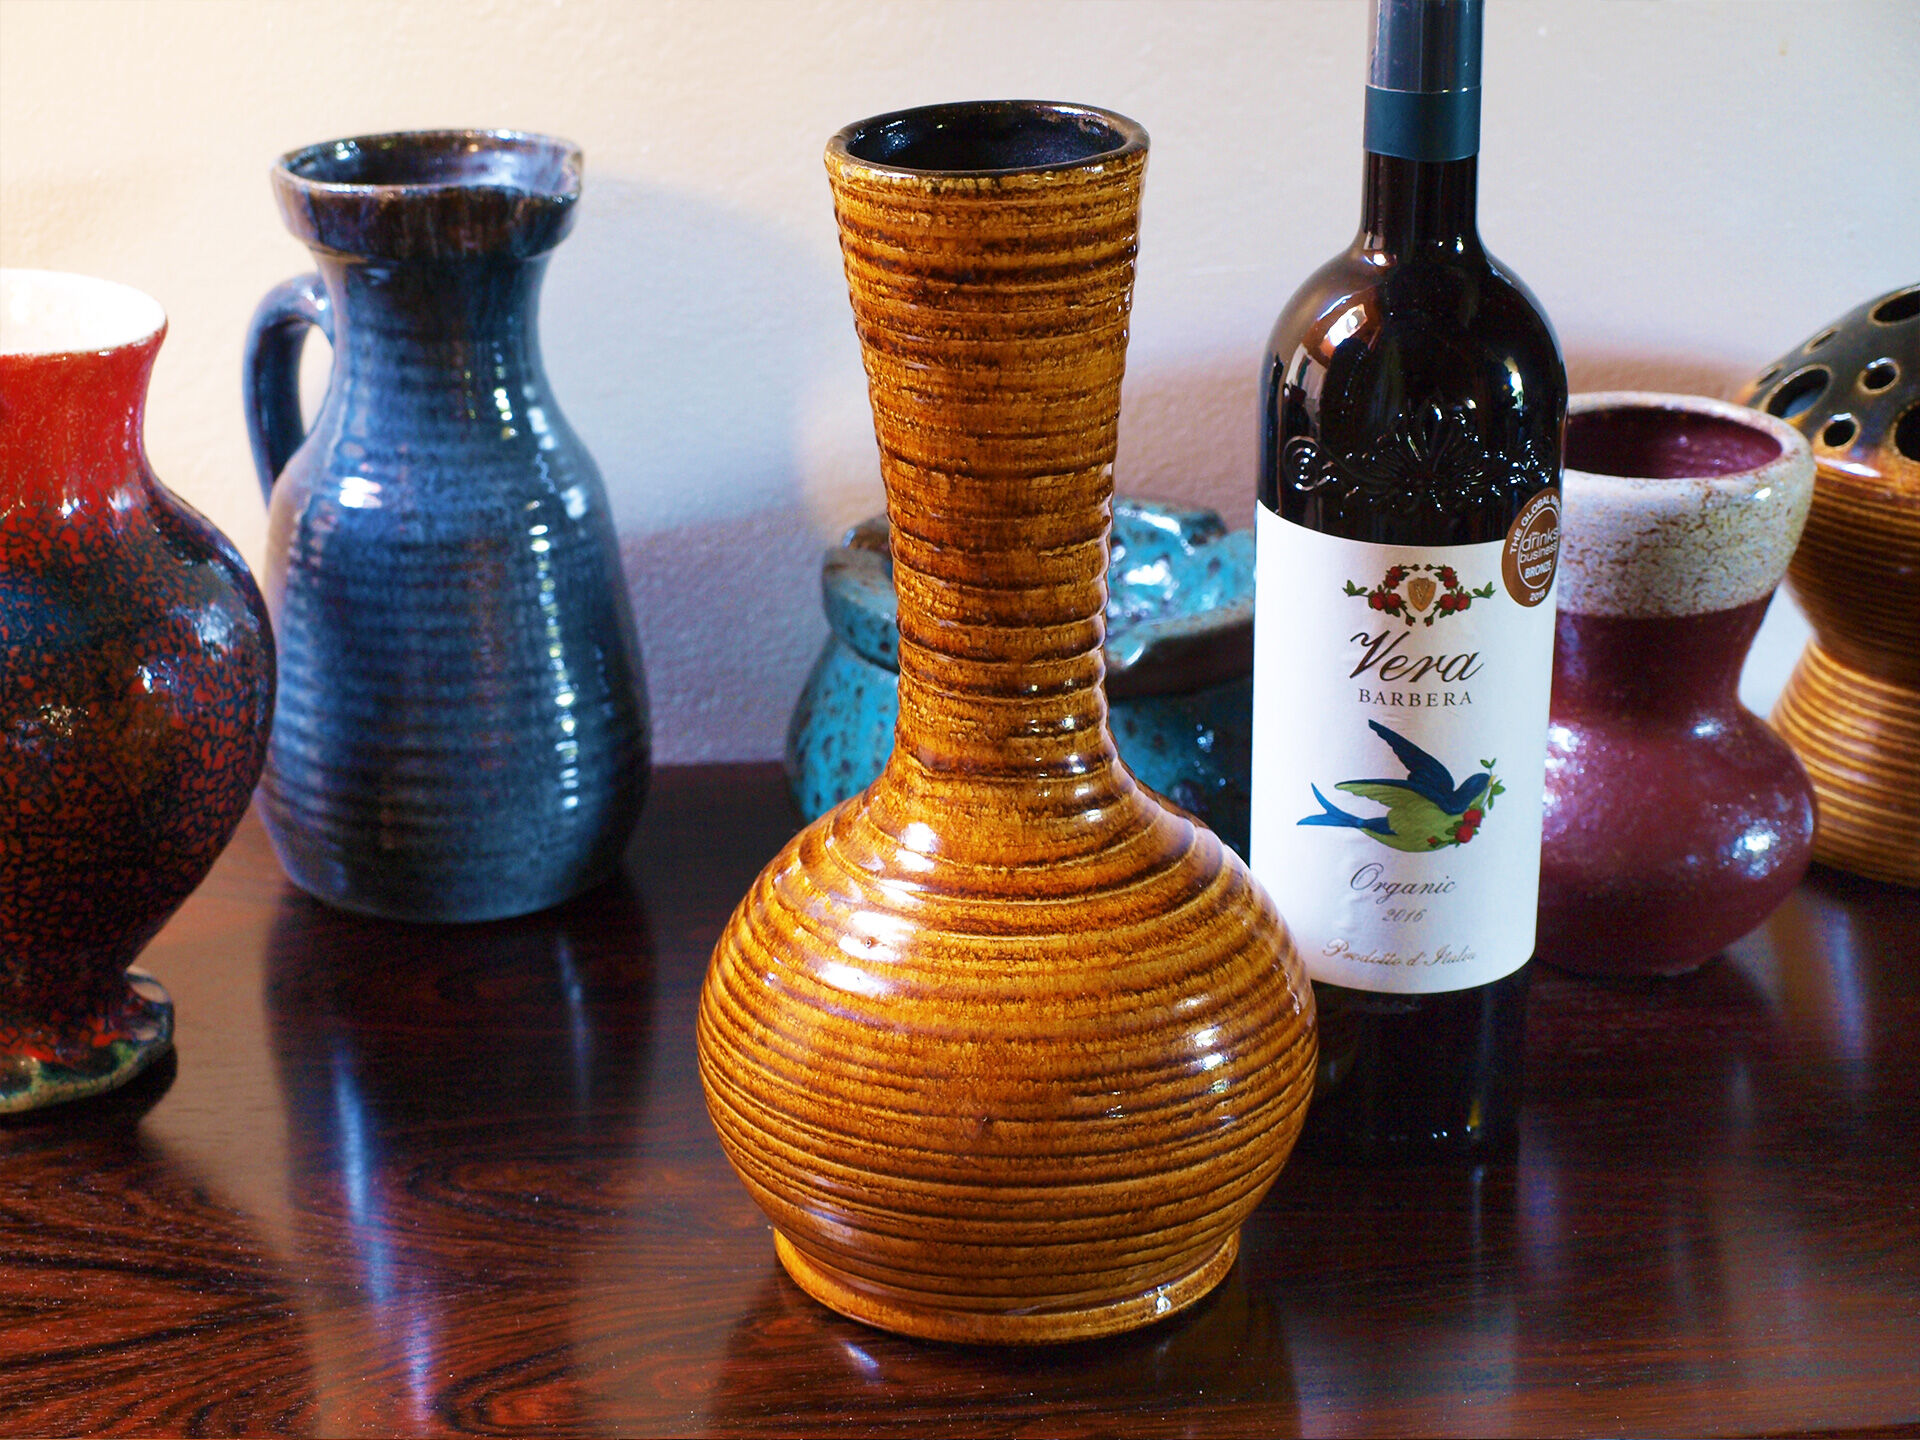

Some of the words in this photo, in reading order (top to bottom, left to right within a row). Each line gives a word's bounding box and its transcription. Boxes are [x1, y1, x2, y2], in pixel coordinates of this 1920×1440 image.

[1509, 528, 1523, 555] THE
[1521, 495, 1550, 527] GLOBAL
[1521, 527, 1559, 552] drinks
[1520, 541, 1557, 564] business
[1524, 560, 1552, 579] BRONZE
[1349, 630, 1484, 683] Vera
[1358, 688, 1472, 707] BARBERA
[1350, 862, 1457, 905] Organic
[1382, 908, 1427, 922] 2016
